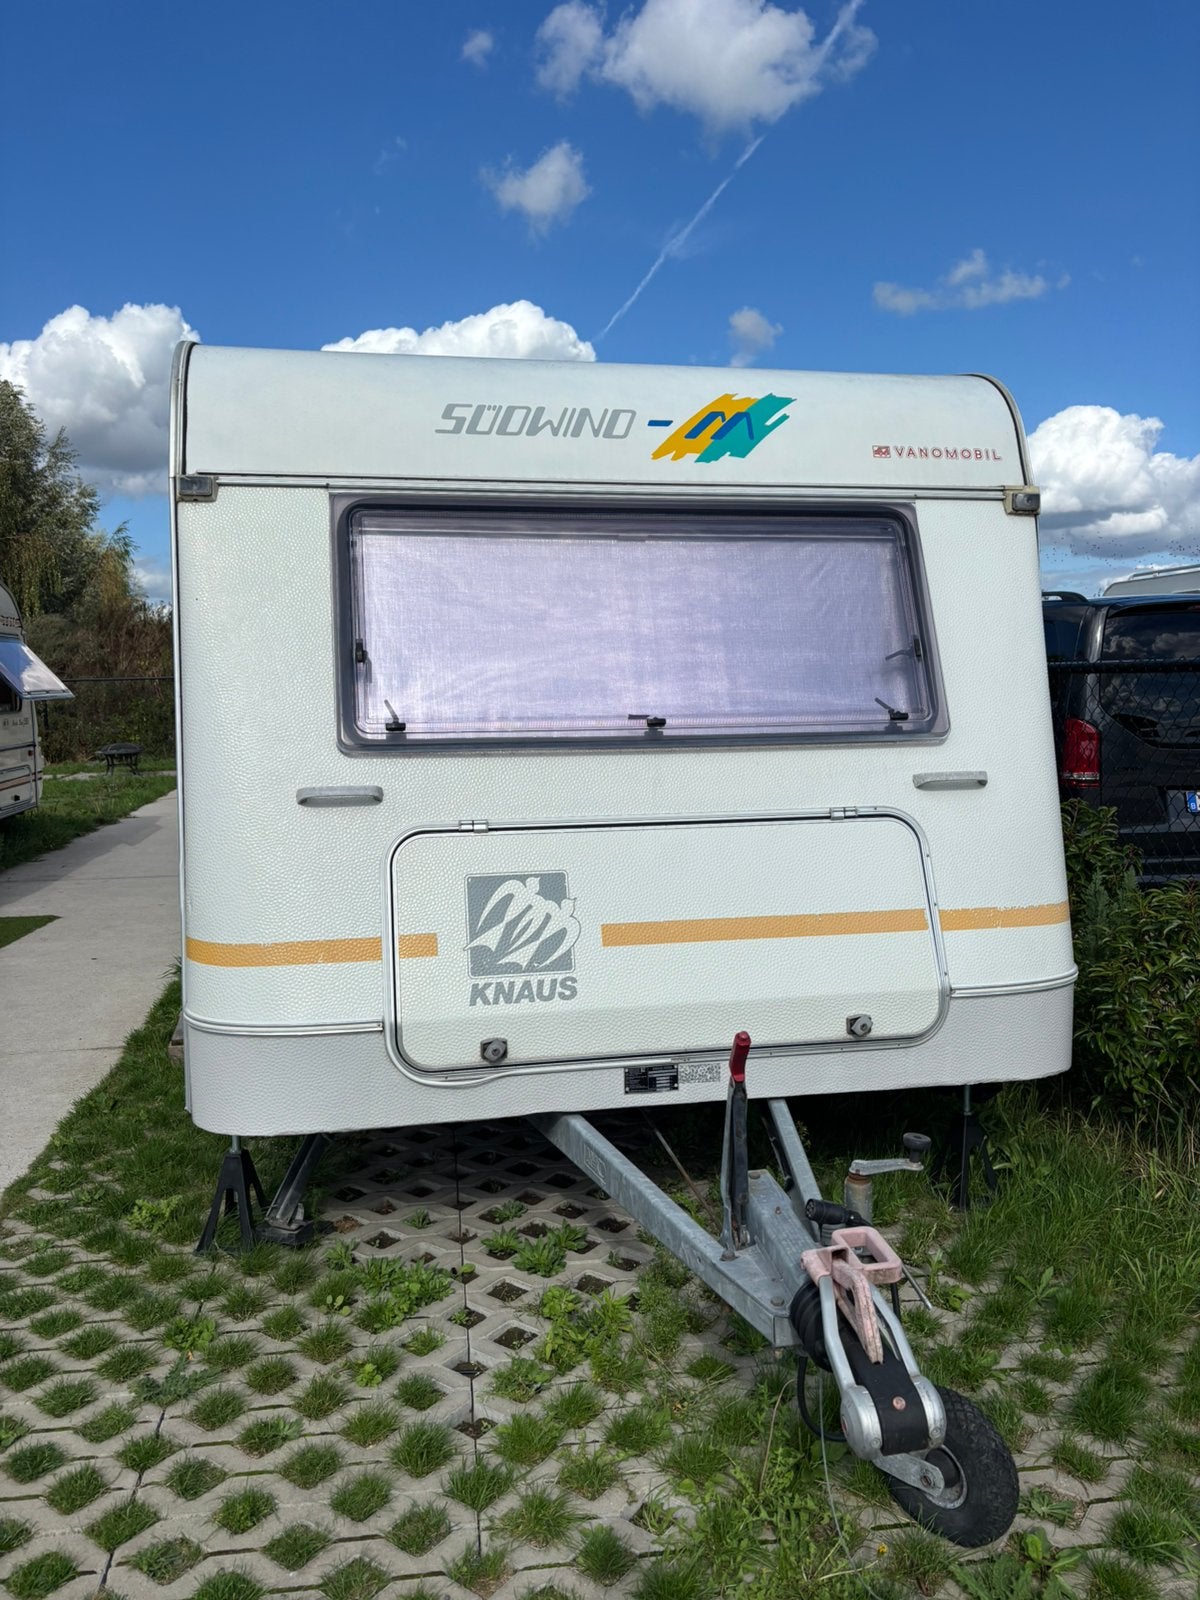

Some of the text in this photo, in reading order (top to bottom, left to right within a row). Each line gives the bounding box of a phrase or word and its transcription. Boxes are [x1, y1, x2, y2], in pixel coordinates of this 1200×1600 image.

[435, 403, 637, 440] SÜDWIND
[893, 445, 1003, 461] VANOMOBIL
[468, 976, 578, 1007] KNAUS
